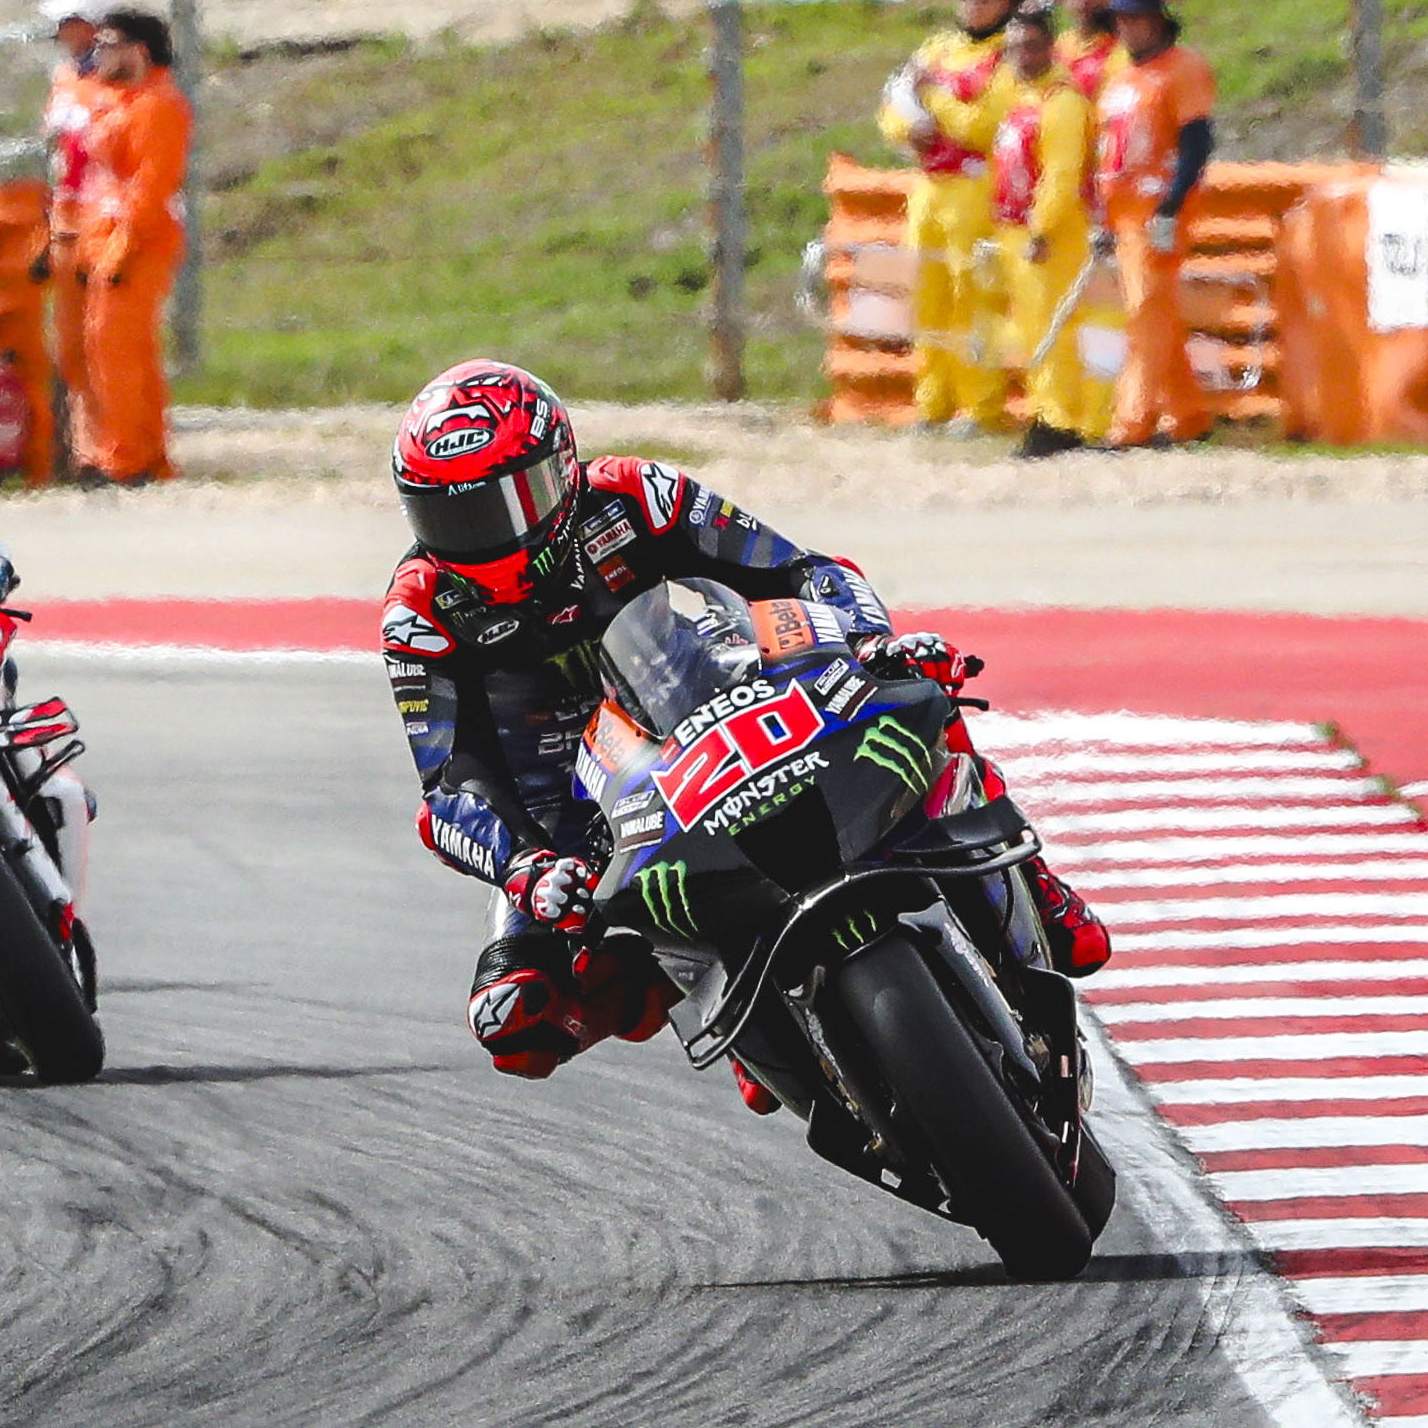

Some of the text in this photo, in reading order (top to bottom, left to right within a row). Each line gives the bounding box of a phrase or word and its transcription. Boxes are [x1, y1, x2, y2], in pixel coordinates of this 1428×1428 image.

[434, 431, 485, 455] HJC
[595, 520, 632, 548] YAMAHA
[770, 601, 802, 635] Beta
[674, 679, 776, 747] ENEOS
[650, 678, 825, 833] 20
[703, 751, 829, 836] MONSTER
[728, 775, 816, 837] ENERGY
[430, 813, 496, 879] YAMAHA
